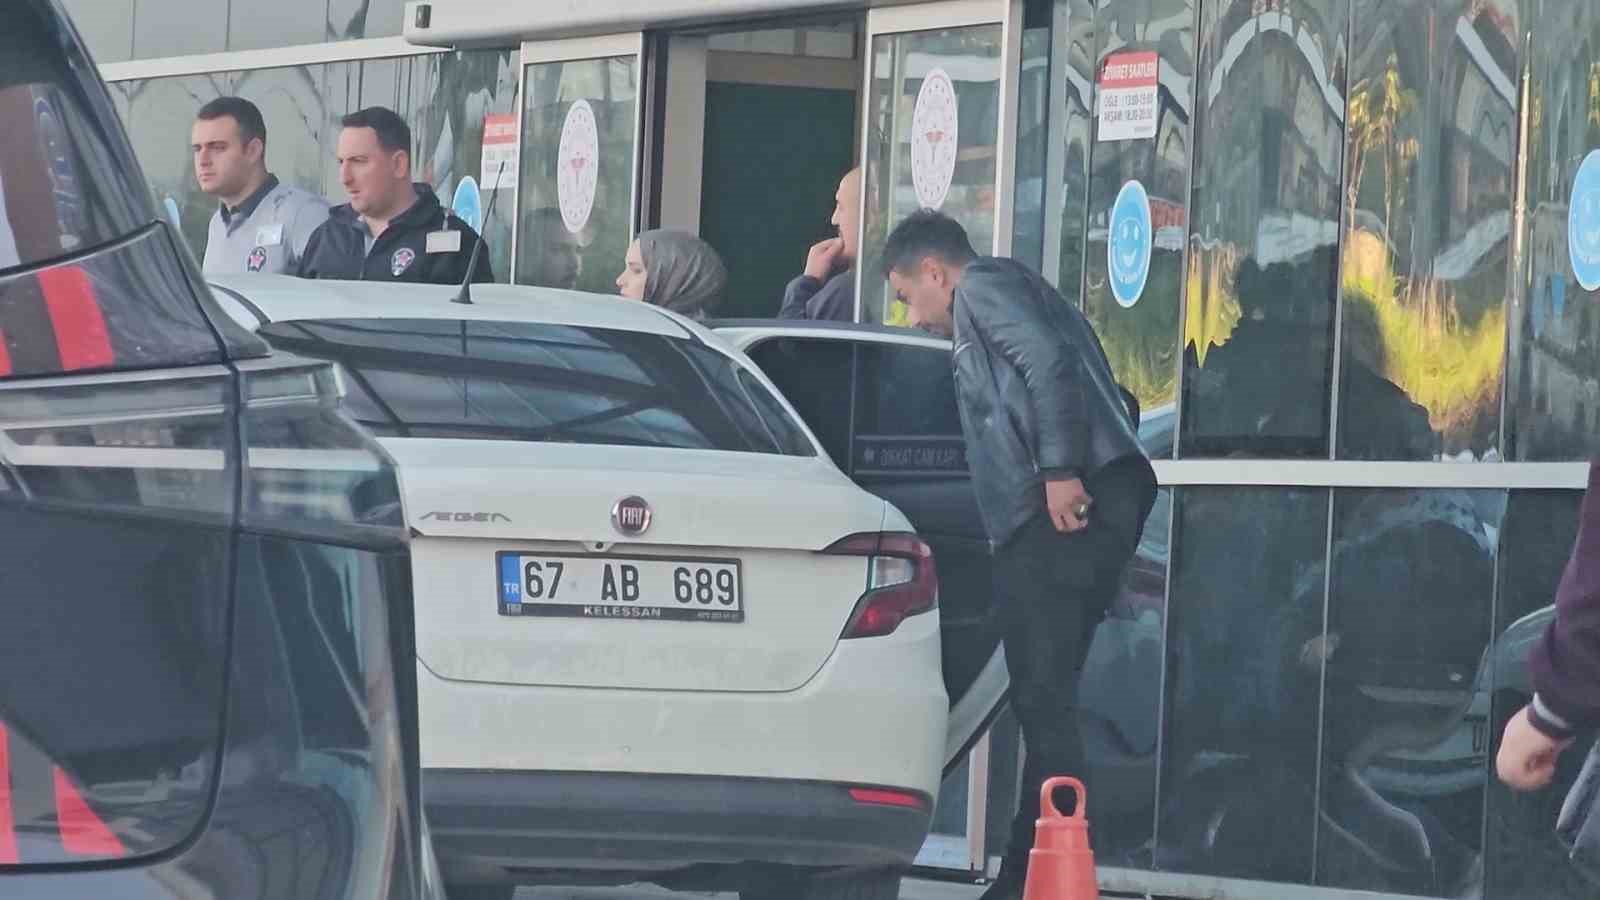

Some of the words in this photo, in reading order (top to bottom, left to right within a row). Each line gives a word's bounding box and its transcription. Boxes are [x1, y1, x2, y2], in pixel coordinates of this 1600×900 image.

[622, 507, 643, 526] FIAT
[503, 582, 520, 595] TR
[524, 561, 564, 599] 67
[601, 564, 640, 601] AB
[673, 566, 735, 606] 689
[583, 604, 661, 617] KELESSAN
